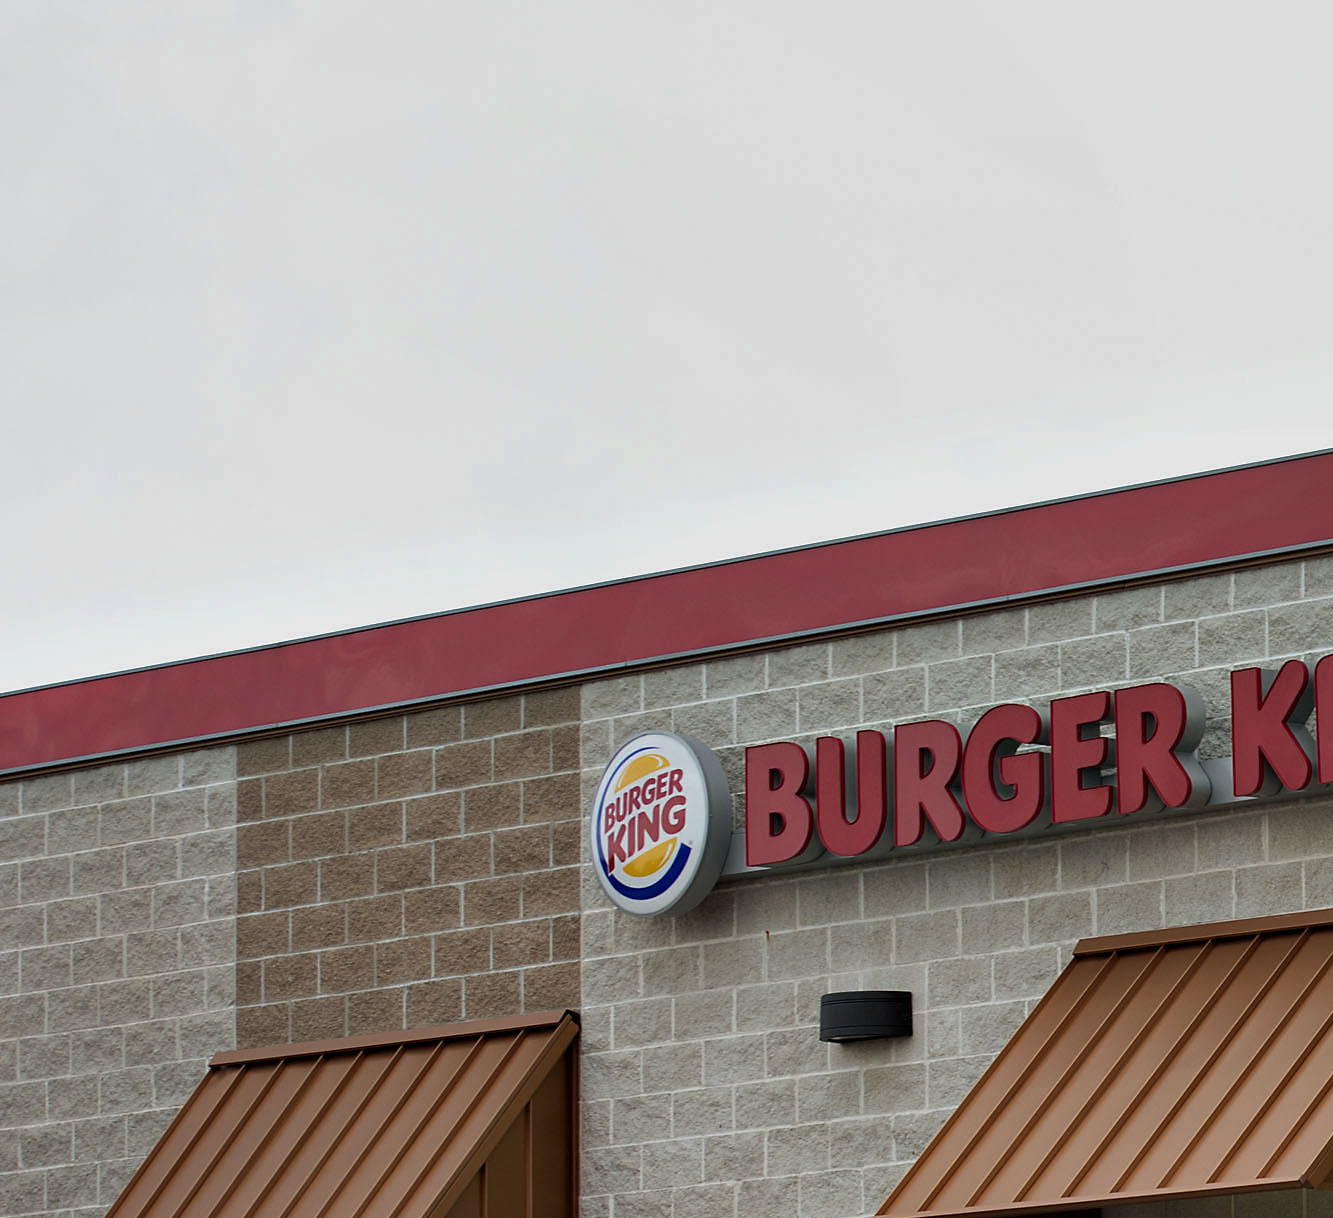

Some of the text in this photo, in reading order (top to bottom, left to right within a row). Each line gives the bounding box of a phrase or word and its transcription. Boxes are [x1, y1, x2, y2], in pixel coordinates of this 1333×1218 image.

[605, 768, 684, 835] BURGER
[745, 682, 1195, 868] BURGER
[607, 795, 687, 874] KING
